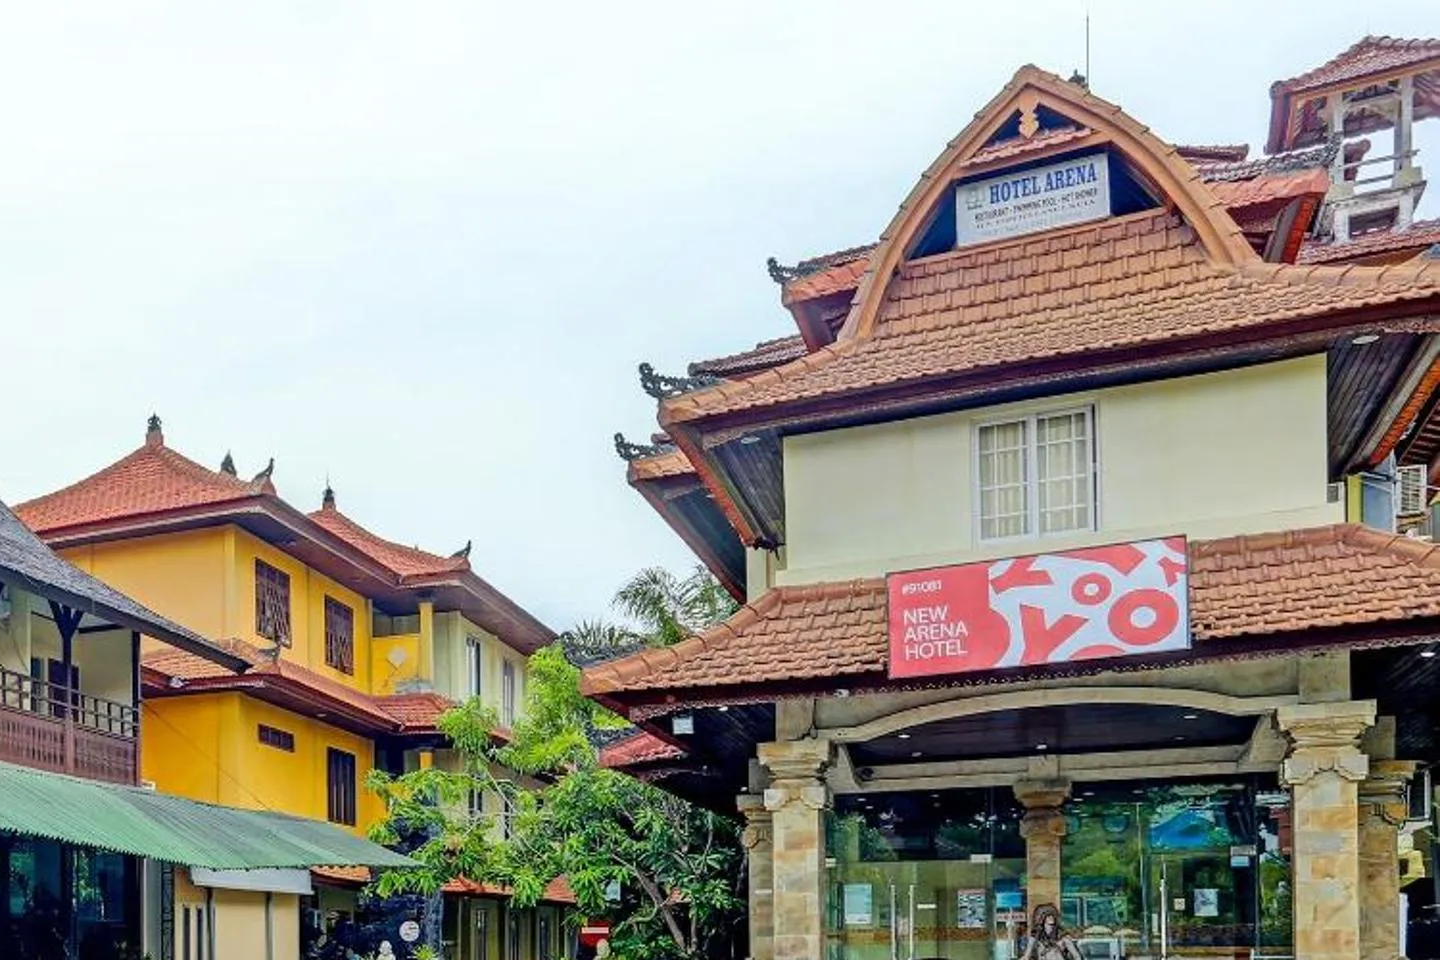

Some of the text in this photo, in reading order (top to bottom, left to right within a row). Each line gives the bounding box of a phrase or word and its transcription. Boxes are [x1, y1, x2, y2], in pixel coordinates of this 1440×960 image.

[990, 163, 1097, 204] HOTEL ARENA
[903, 605, 948, 627] NEW
[903, 620, 969, 643] ARENA
[905, 639, 969, 661] HOTEL
